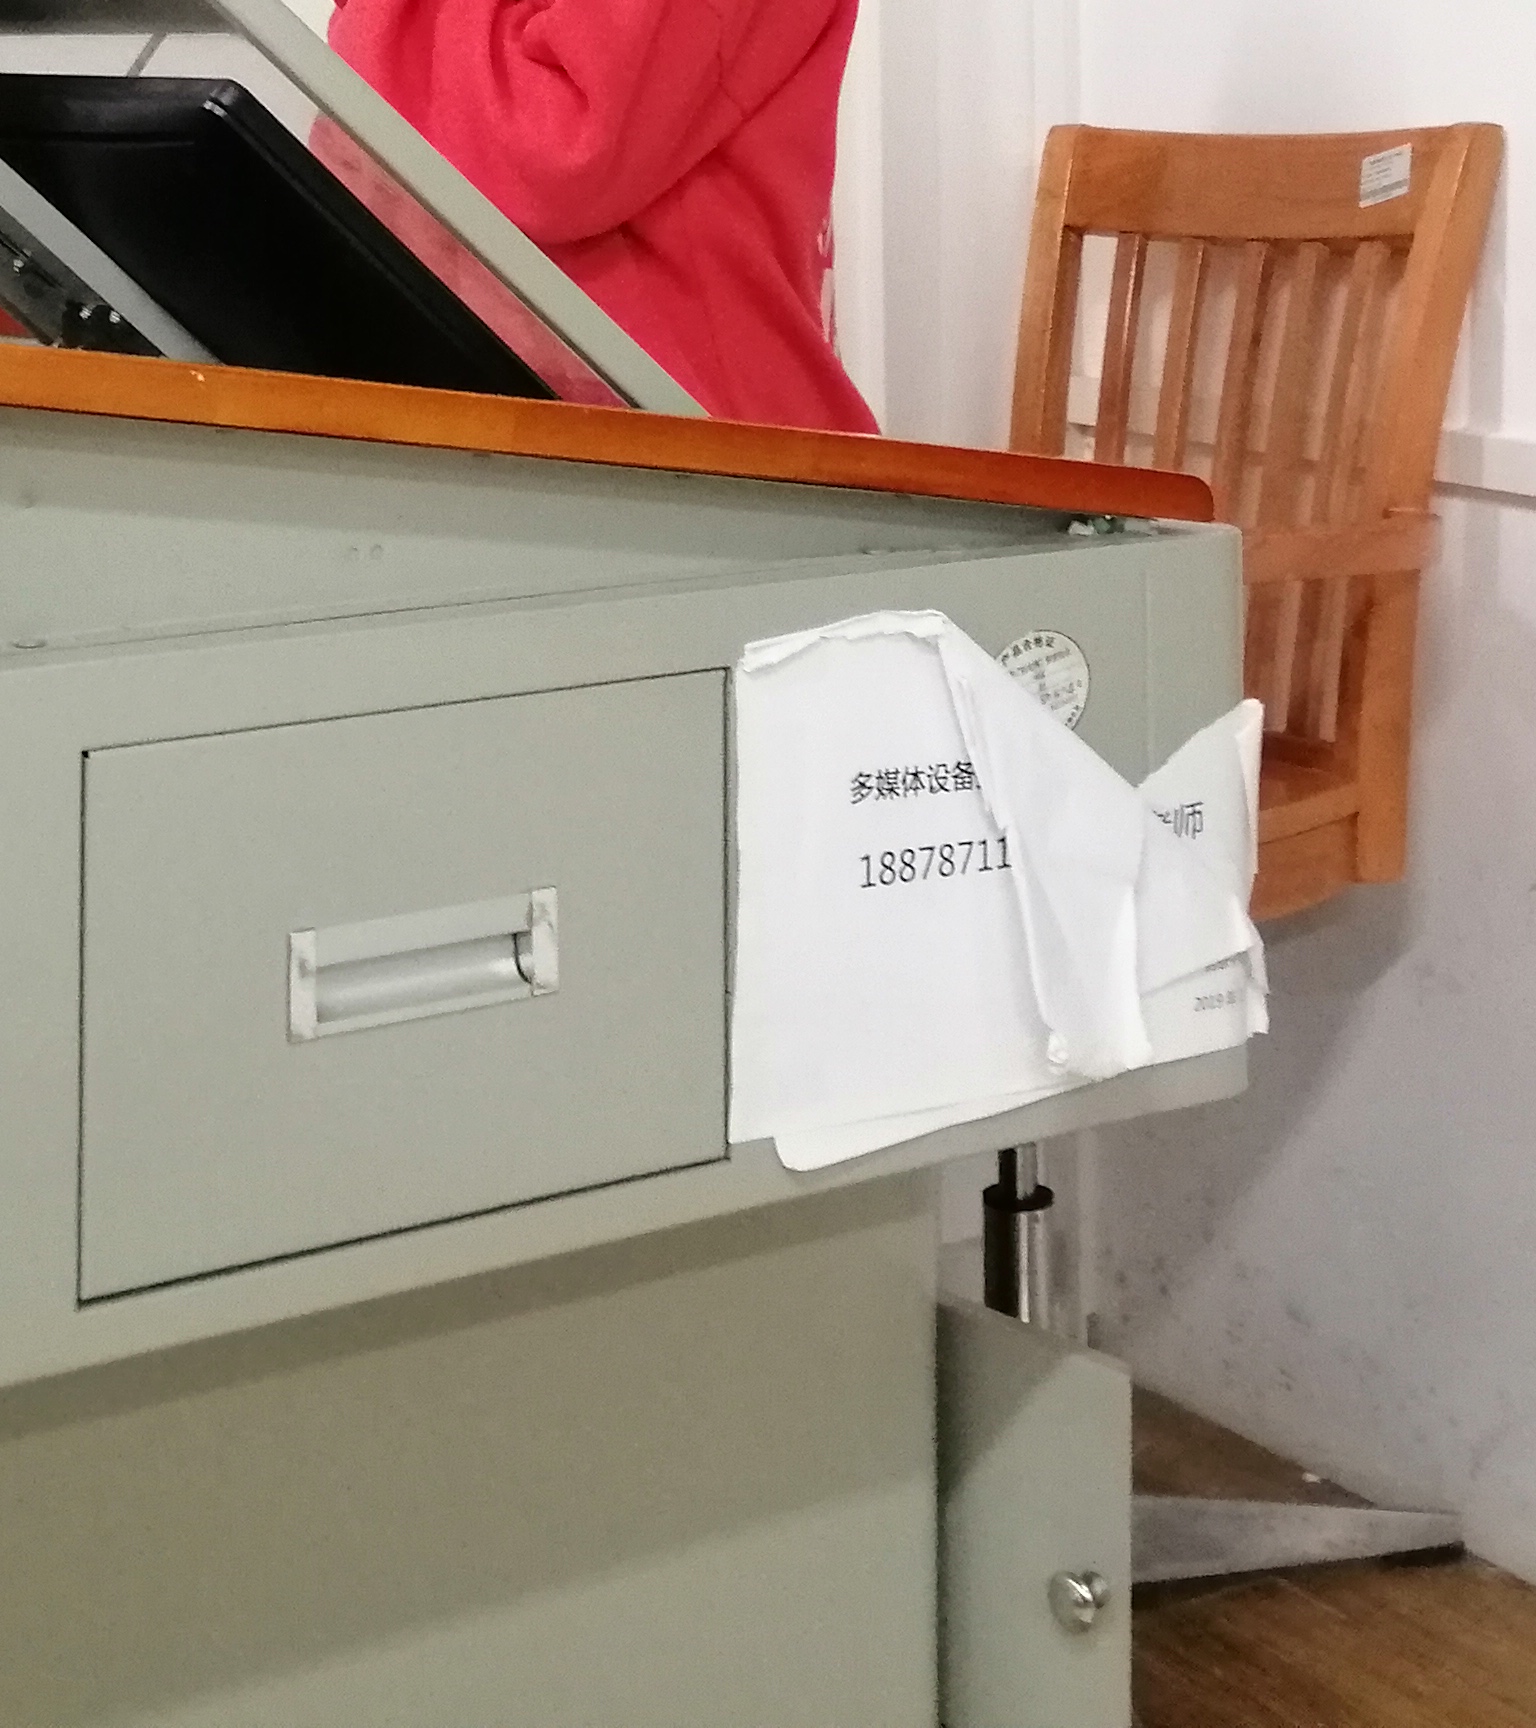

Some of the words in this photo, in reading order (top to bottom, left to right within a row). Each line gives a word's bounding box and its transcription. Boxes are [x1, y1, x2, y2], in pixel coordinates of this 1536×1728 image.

[850, 761, 981, 805] 多媒体设备
[860, 836, 1012, 889] 18878711
